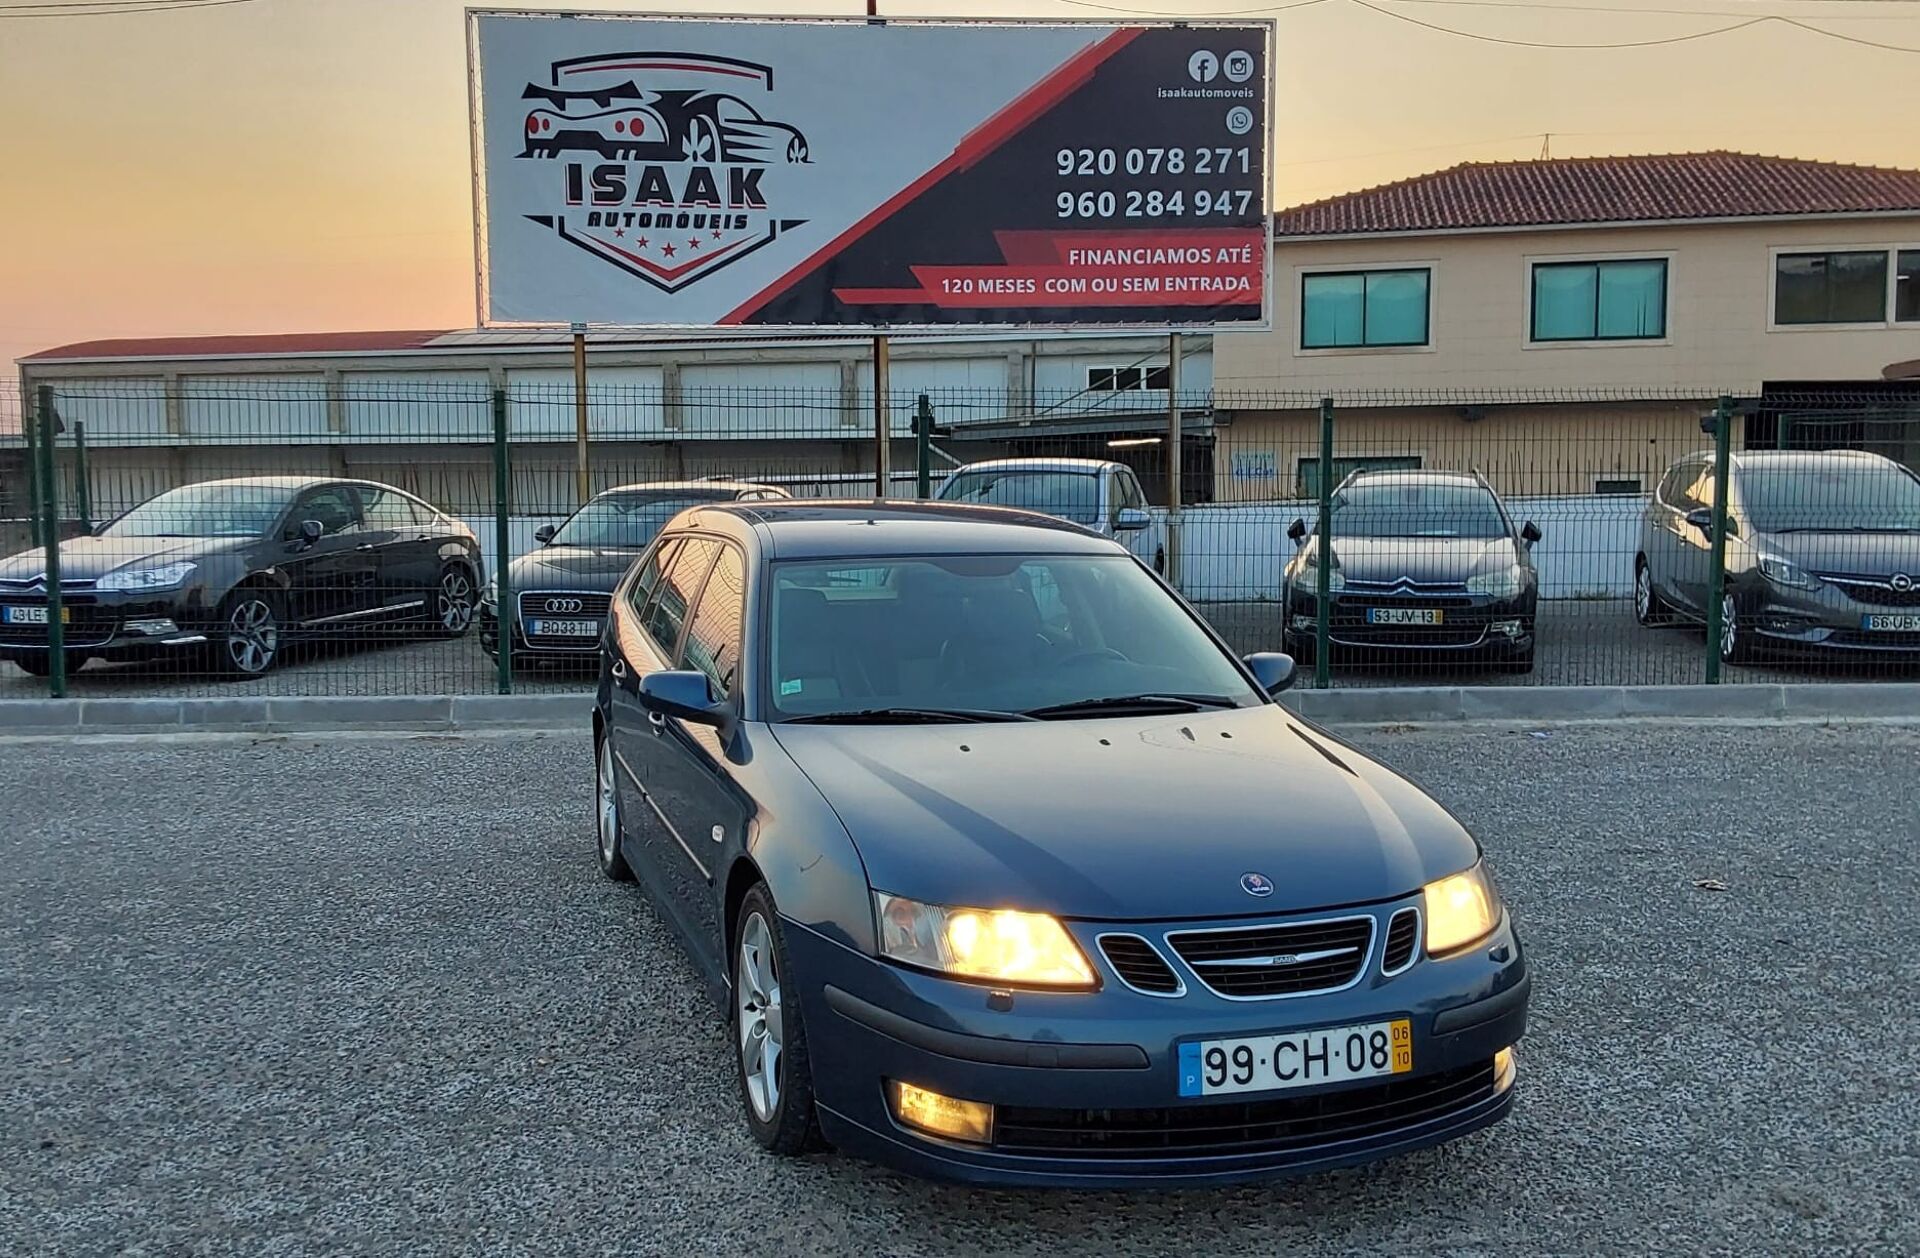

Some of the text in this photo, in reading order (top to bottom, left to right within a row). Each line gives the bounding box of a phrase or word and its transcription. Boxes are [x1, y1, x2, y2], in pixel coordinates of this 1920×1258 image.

[1157, 87, 1254, 98] isaakautomoveis
[1056, 147, 1250, 176] 920 078 271
[565, 163, 768, 210] ISAAK
[1056, 190, 1253, 218] 960 284 947
[1069, 244, 1252, 265] FINANCIAMOS ATÉ
[942, 276, 1250, 294] 120 MESES COM OU SEM ENTRADA
[1393, 1026, 1409, 1041] 06
[1396, 1051, 1410, 1067] 10
[1186, 1076, 1195, 1087] P
